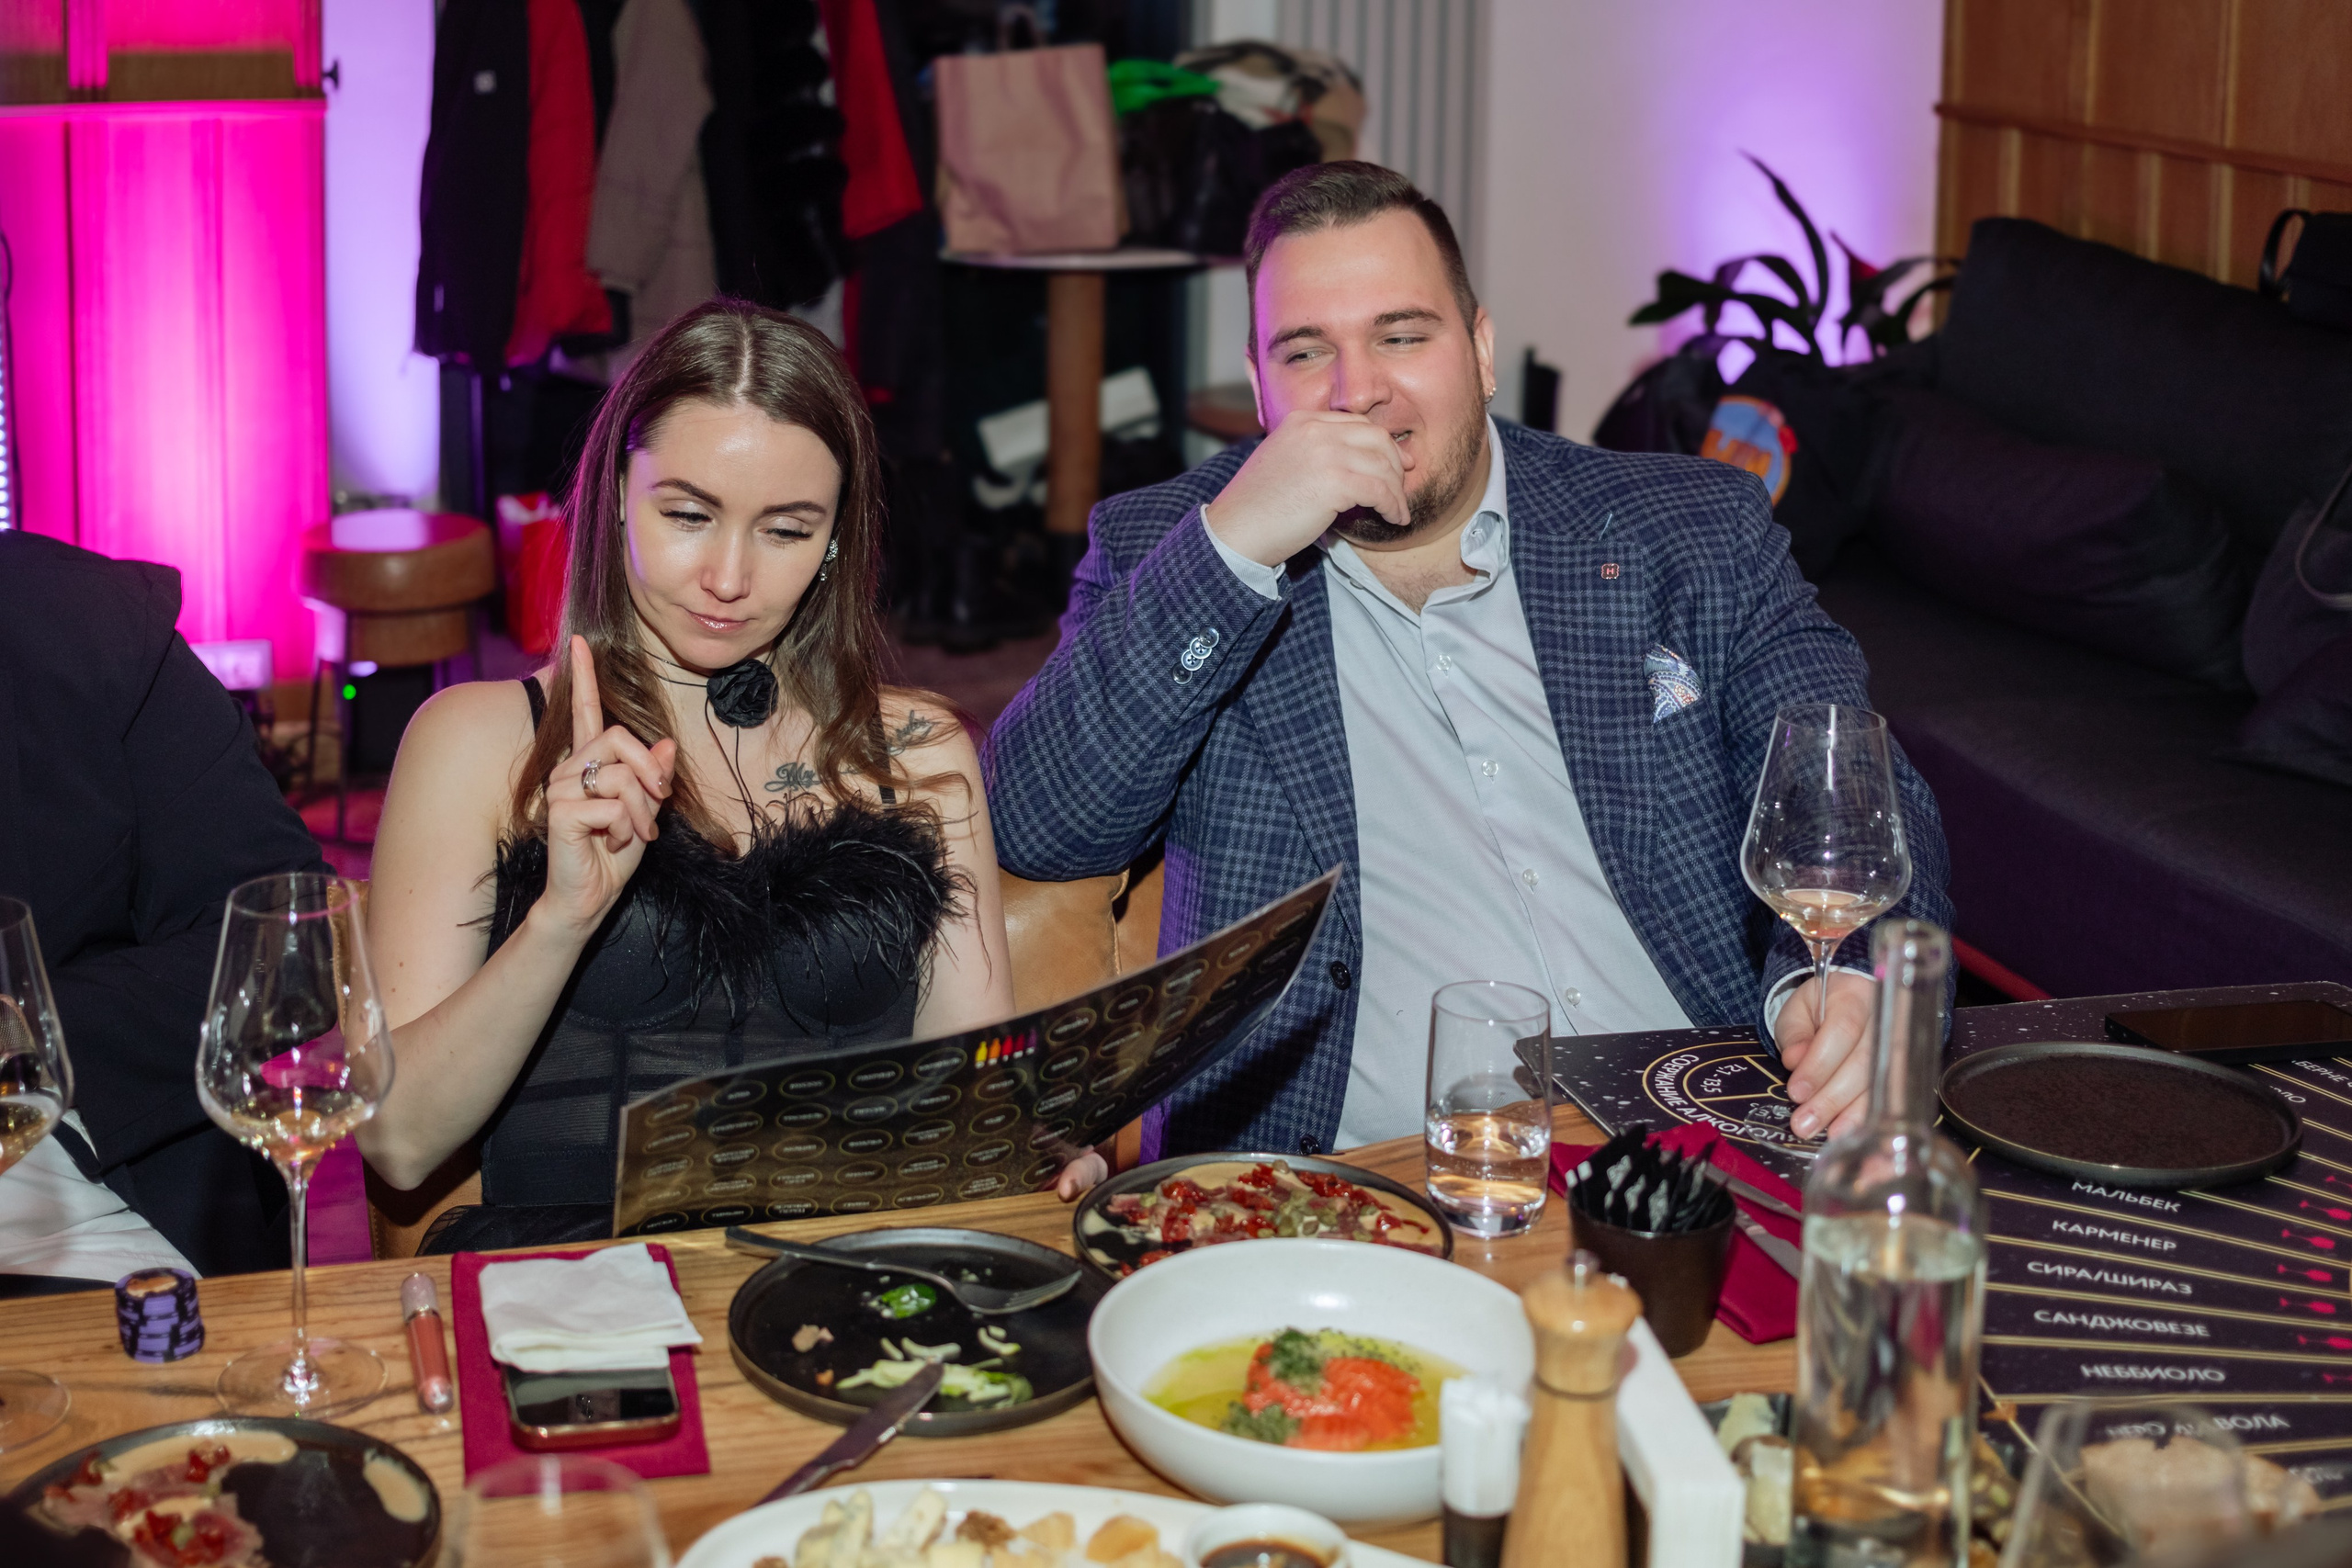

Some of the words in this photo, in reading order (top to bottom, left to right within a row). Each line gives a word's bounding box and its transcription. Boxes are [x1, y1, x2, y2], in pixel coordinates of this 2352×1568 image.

[1715, 1064, 1748, 1077] 12,1
[1700, 1077, 1723, 1093] 13,5
[2071, 1181, 2182, 1213] МАЛЬБЕК
[2052, 1219, 2177, 1251] КАРМЕНЕР
[2027, 1261, 2193, 1295] СИРА/ШИРАЗ
[2033, 1310, 2211, 1337] САНДЖОВЕЗЕ
[2079, 1364, 2226, 1382] НЕББИОЛО
